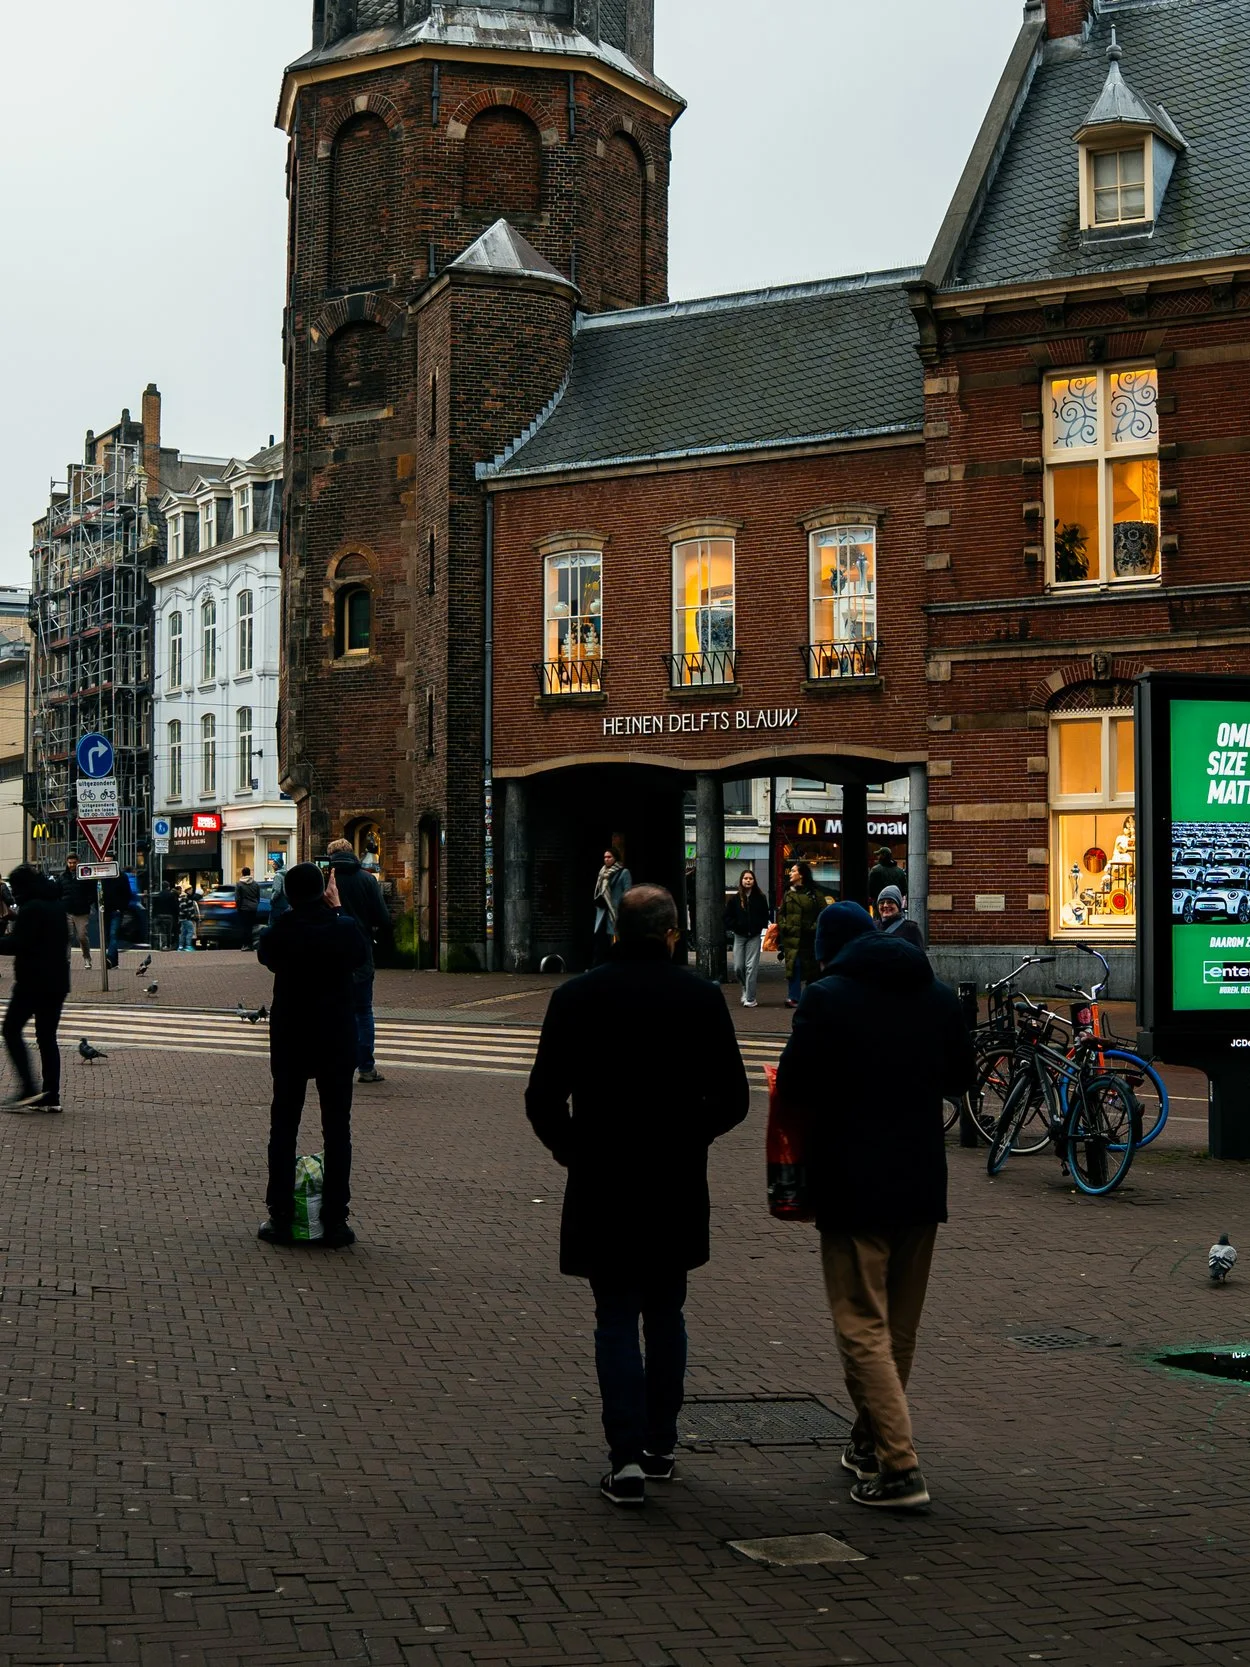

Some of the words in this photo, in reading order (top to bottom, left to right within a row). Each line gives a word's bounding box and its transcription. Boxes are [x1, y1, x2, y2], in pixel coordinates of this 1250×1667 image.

[603, 715, 663, 736] HEINEN
[669, 711, 729, 732] DELFTS
[1206, 751, 1249, 776] SIZE
[1209, 936, 1244, 948] DAAROM
